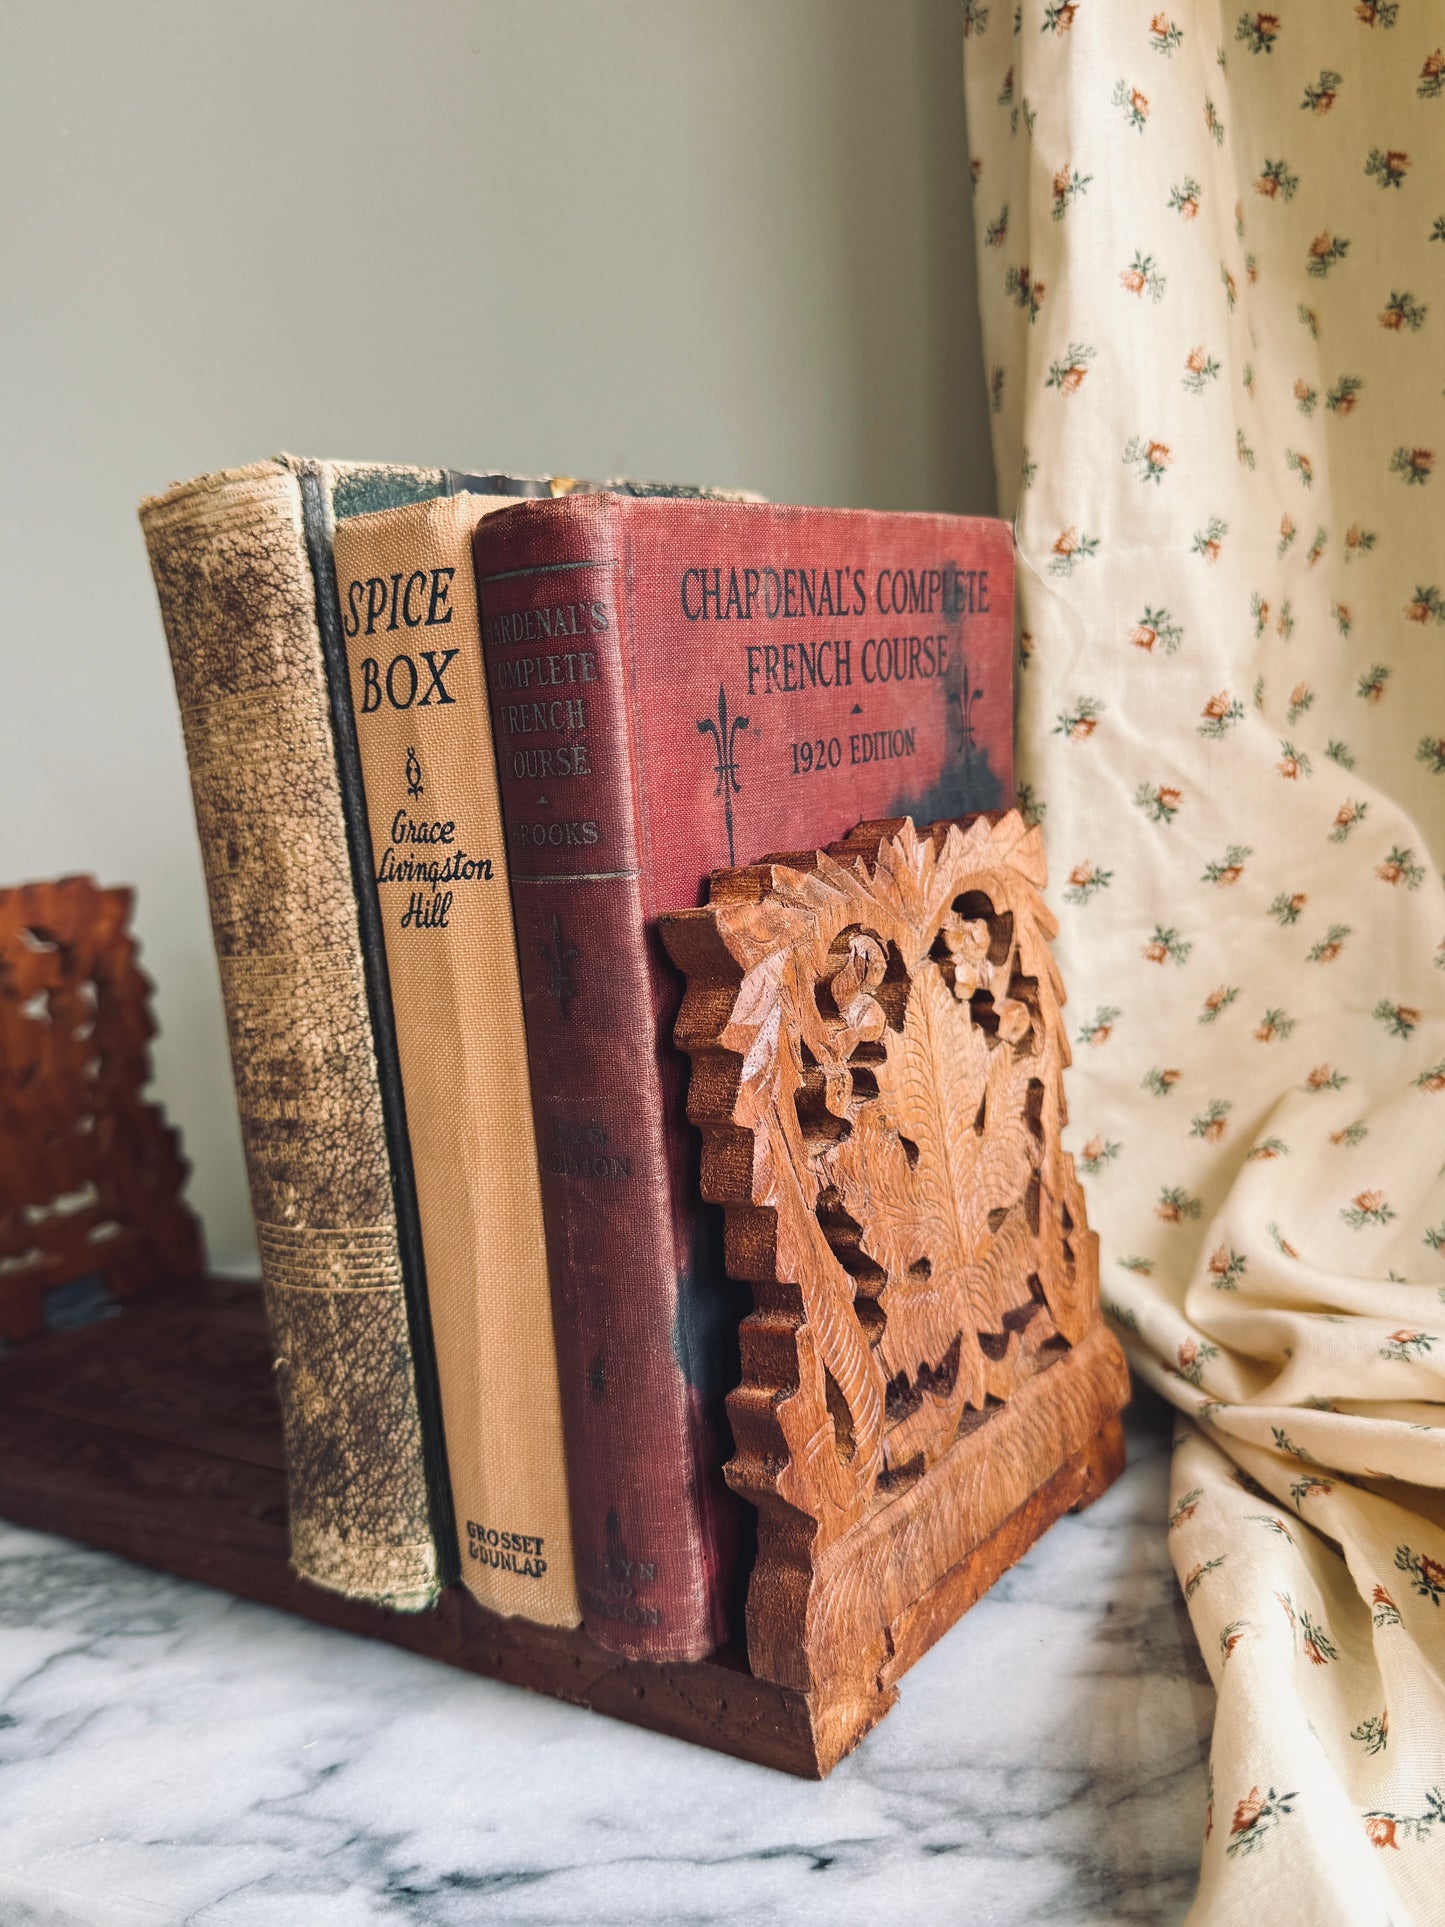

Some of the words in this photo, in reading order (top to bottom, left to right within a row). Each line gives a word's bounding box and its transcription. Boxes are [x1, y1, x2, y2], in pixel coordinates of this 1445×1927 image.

[344, 568, 455, 638] SPICE
[876, 569, 990, 614] COMPLETE
[486, 602, 610, 646] HARDENAL'S
[361, 648, 460, 713] BOX
[491, 652, 598, 690] COMPLETE
[745, 640, 852, 695] FRENCH
[861, 635, 950, 684] COURSE
[501, 699, 587, 734] FRENCH
[505, 747, 592, 779] COURSE
[792, 738, 842, 775] 1920
[850, 727, 917, 765] EDITION
[391, 809, 455, 844] Grace
[377, 847, 494, 893] Livingston
[400, 891, 453, 928] Hill
[466, 1520, 544, 1556] GROSSET
